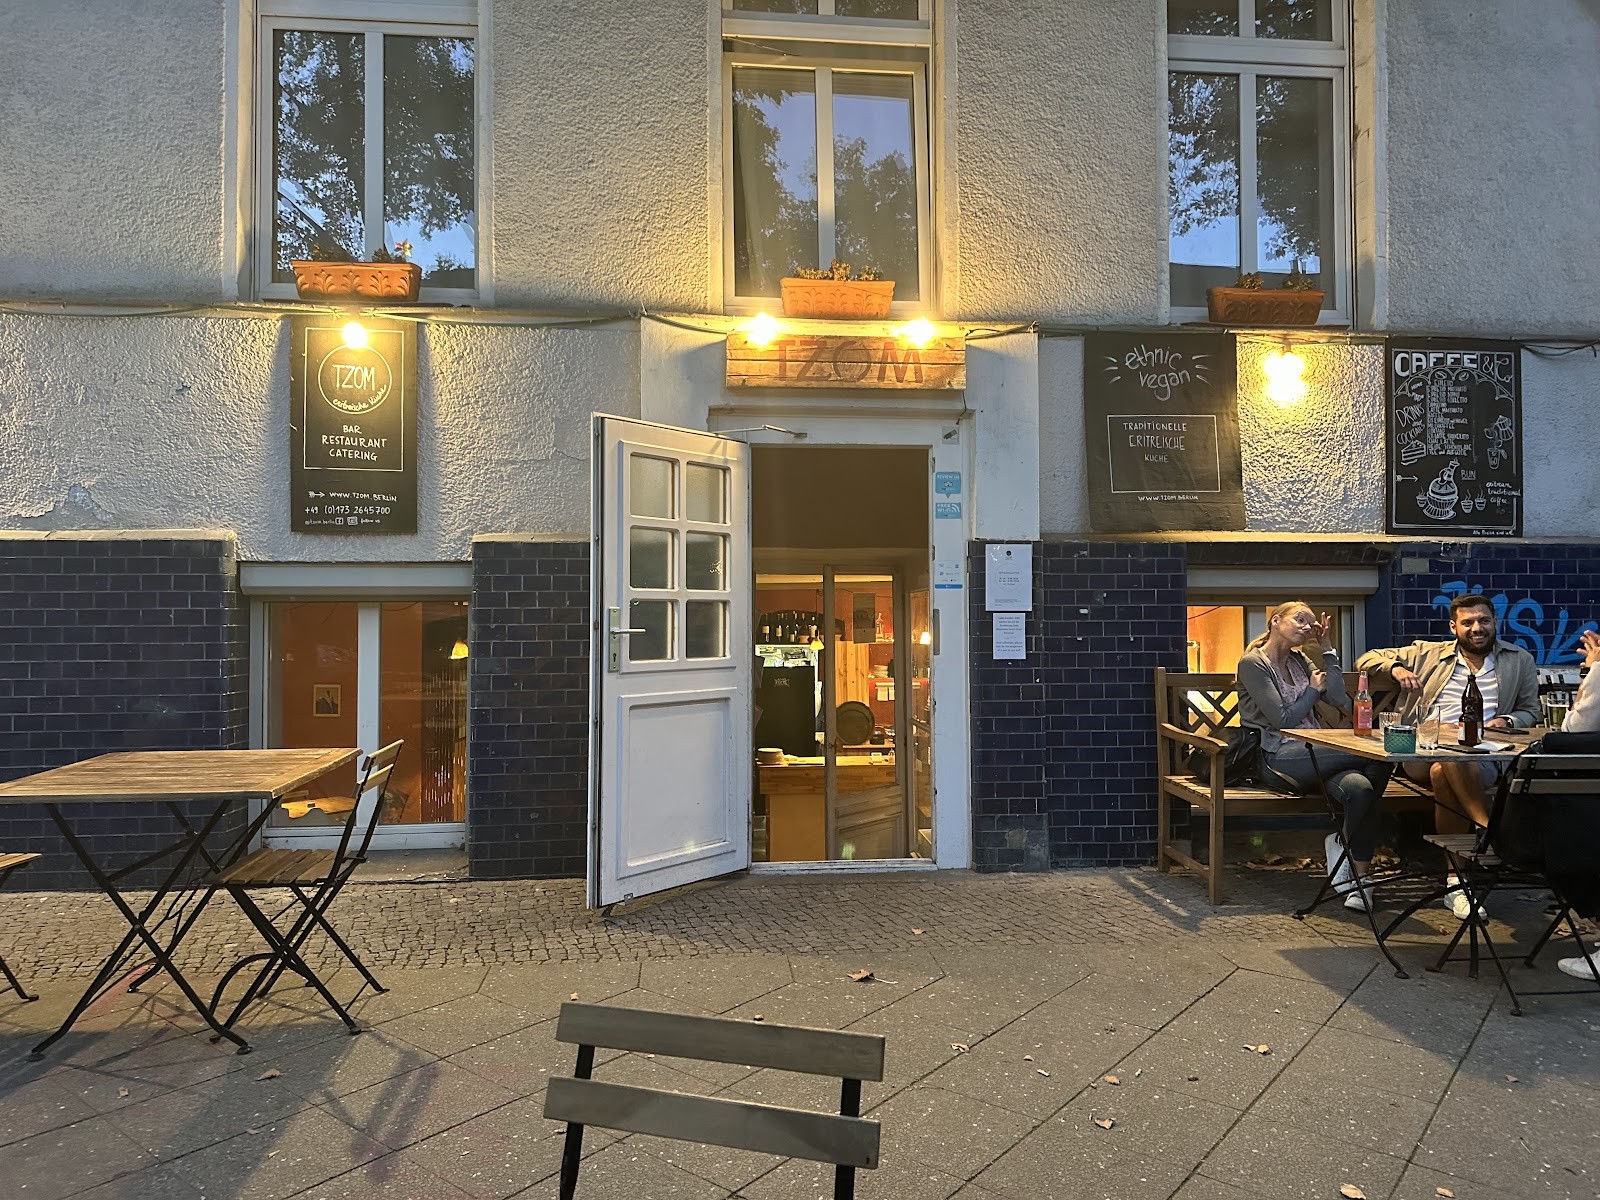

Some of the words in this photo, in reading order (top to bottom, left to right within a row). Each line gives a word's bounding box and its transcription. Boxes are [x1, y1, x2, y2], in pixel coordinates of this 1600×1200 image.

[773, 339, 924, 384] TZOM
[1124, 343, 1183, 370] ethnic
[1394, 352, 1478, 377] CAFFE
[332, 364, 376, 392] TZOM
[1138, 369, 1191, 402] vegan
[1122, 420, 1188, 432] TRADITIONELLE
[1395, 402, 1425, 428] DRINKS
[342, 424, 362, 435] BAR
[1396, 423, 1425, 445] COCKTAILS
[321, 434, 388, 449] RESTAURANT
[1128, 434, 1186, 451] ERITREISCHE
[329, 448, 378, 462] CATERING
[304, 506, 319, 514] +49
[324, 504, 350, 515] (0)173
